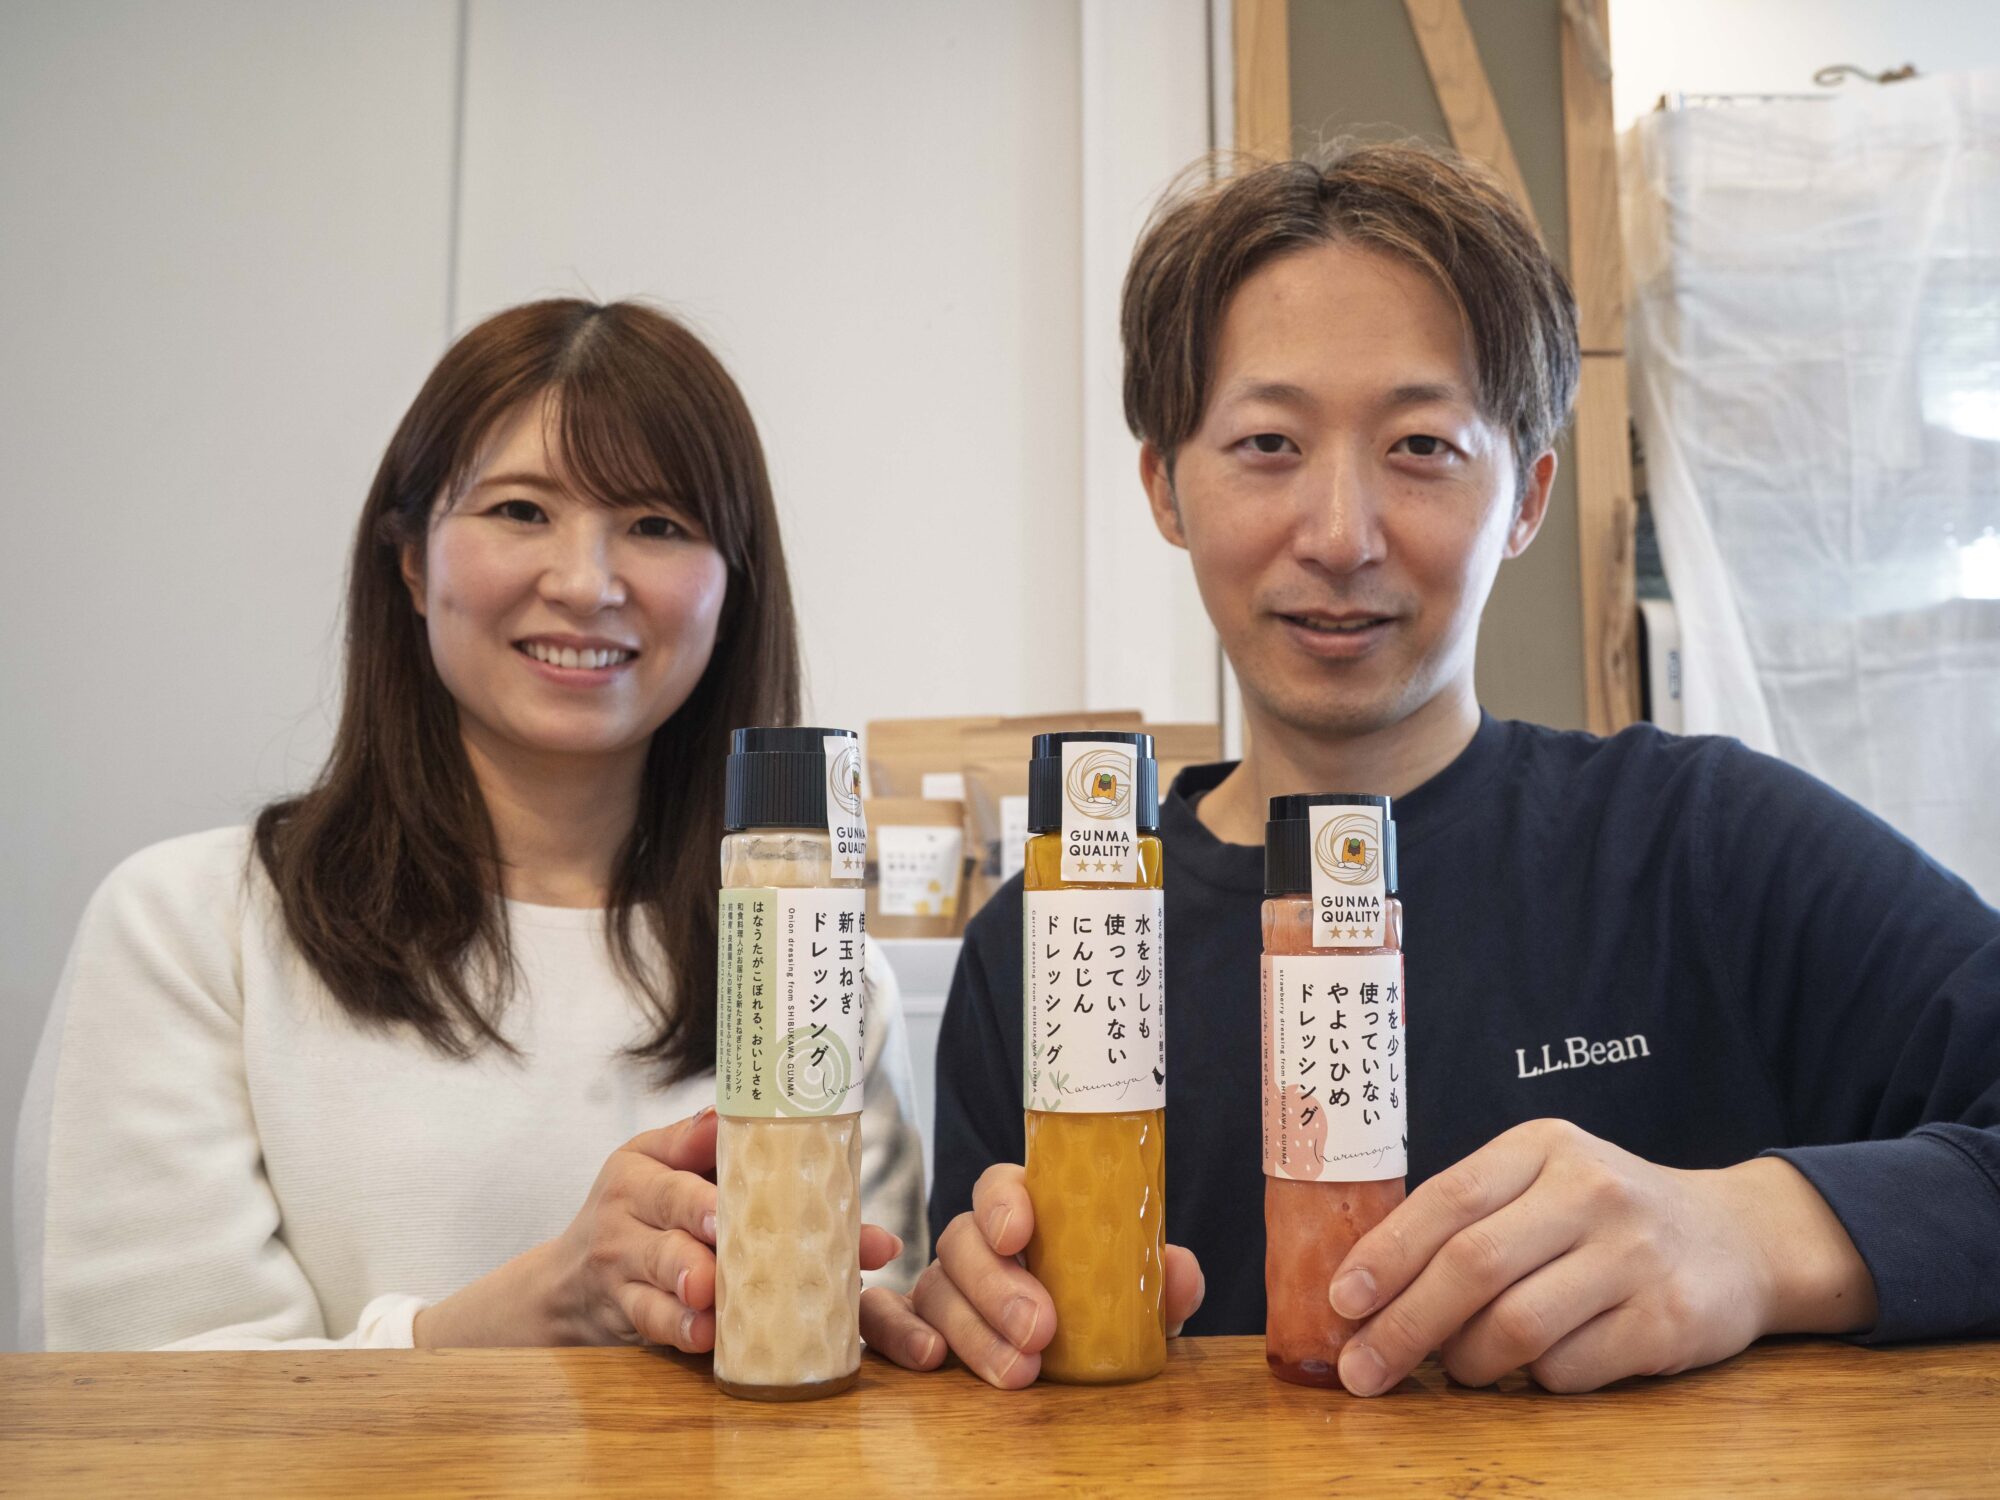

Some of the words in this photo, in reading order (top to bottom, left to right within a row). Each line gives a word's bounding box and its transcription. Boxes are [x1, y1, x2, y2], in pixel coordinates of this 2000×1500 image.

[1069, 830, 1130, 842] GUNMA
[1069, 844, 1130, 857] QUALITY
[788, 907, 796, 934] Onion
[1321, 896, 1380, 908] GUNMA
[1321, 911, 1380, 923] QUALITY
[751, 901, 764, 1100] はなうたがこぼれる、おいしさを
[786, 938, 795, 978] dressing
[787, 981, 795, 1002] from
[809, 912, 829, 1067] ドレッシング
[838, 911, 854, 1015] 新玉ねぎ
[1045, 915, 1063, 1065] ドレッシング
[1073, 916, 1094, 1013] にんじん
[1104, 913, 1127, 1064] 使っていない
[1135, 914, 1151, 1038] 水を少しも
[787, 1005, 795, 1060] SHIBUKAWA
[787, 1064, 795, 1097] GUNMA
[1298, 983, 1319, 1126] ドレッシング
[1327, 982, 1350, 1107] やよいひめ
[1359, 982, 1380, 1125] 使っていない
[1386, 982, 1399, 1109] 水を少しも
[1515, 1033, 1651, 1079] L.L.Bean
